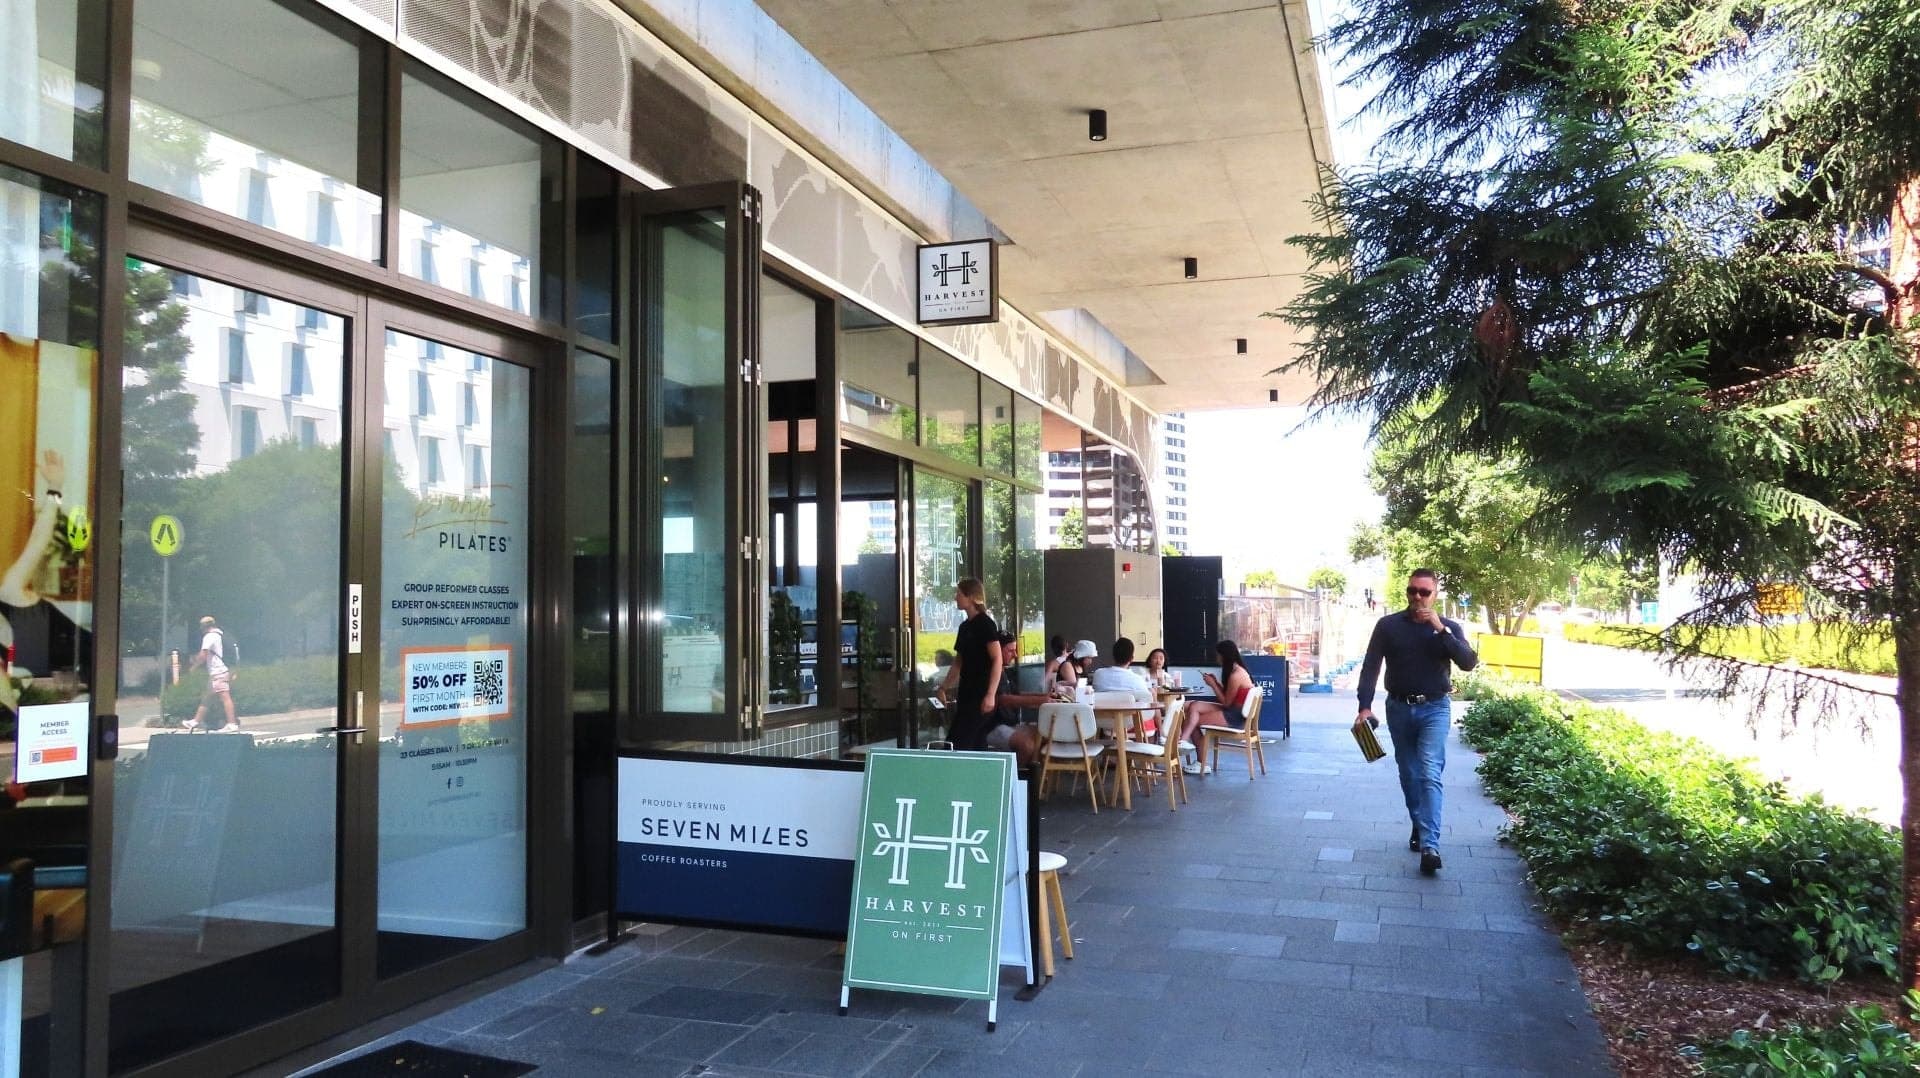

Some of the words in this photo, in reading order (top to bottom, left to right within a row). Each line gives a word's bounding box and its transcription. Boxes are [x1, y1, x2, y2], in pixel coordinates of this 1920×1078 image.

[924, 290, 985, 301] HARVEST
[439, 532, 507, 552] PILATES
[404, 583, 434, 593] GROUP
[435, 584, 477, 594] REFORMER
[479, 585, 509, 594] CLASSES
[391, 600, 423, 609] EXPERT
[425, 600, 470, 610] ON-SCREEN
[471, 600, 519, 610] INSTRUCTION
[402, 617, 458, 626] SURPRISINGLY
[460, 617, 511, 626] AFFORDABLE!
[412, 662, 431, 672] NEW
[432, 660, 468, 671] MEMBERS
[412, 675, 439, 690] 50%
[442, 673, 467, 687] OFF
[412, 692, 434, 703] FIRST
[436, 690, 466, 701] MONTH
[412, 705, 429, 713] WITH
[40, 720, 70, 728] MEMBER
[41, 728, 68, 736] ACCESS
[408, 748, 435, 758] CLASSES
[435, 745, 453, 754] DAILY
[642, 798, 683, 808] PROUDLY
[687, 801, 726, 811] SERVING
[641, 817, 720, 841] SEVEN
[730, 823, 809, 848] MILES
[641, 854, 676, 864] COFFEE
[680, 857, 728, 868] ROASTERS
[865, 896, 986, 918] HARVEST
[892, 930, 908, 939] ON
[915, 932, 953, 943] FIRST
